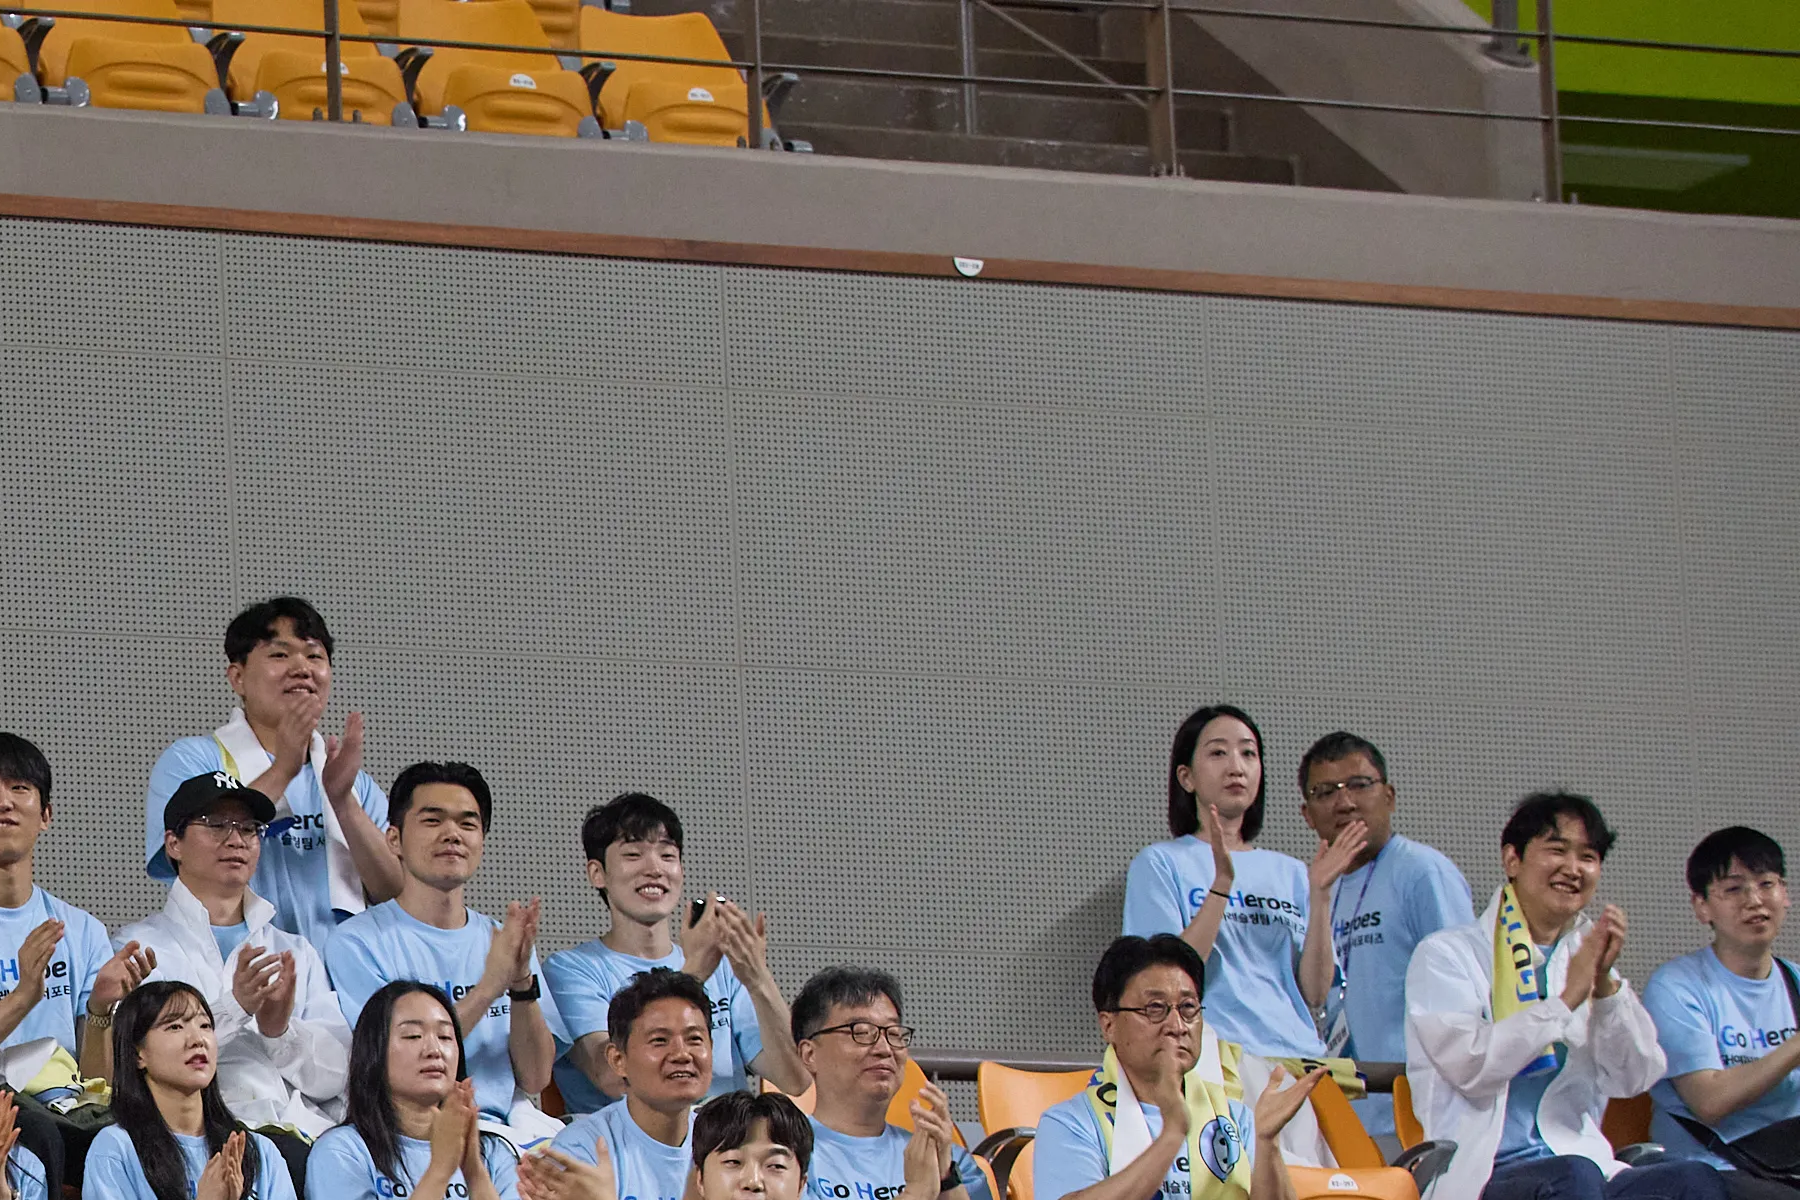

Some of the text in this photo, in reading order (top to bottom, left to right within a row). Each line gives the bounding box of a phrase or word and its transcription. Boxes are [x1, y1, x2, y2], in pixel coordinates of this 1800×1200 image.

[1720, 1025, 1747, 1048] Go
[377, 1176, 407, 1199] Go
[817, 1177, 850, 1199] Go
